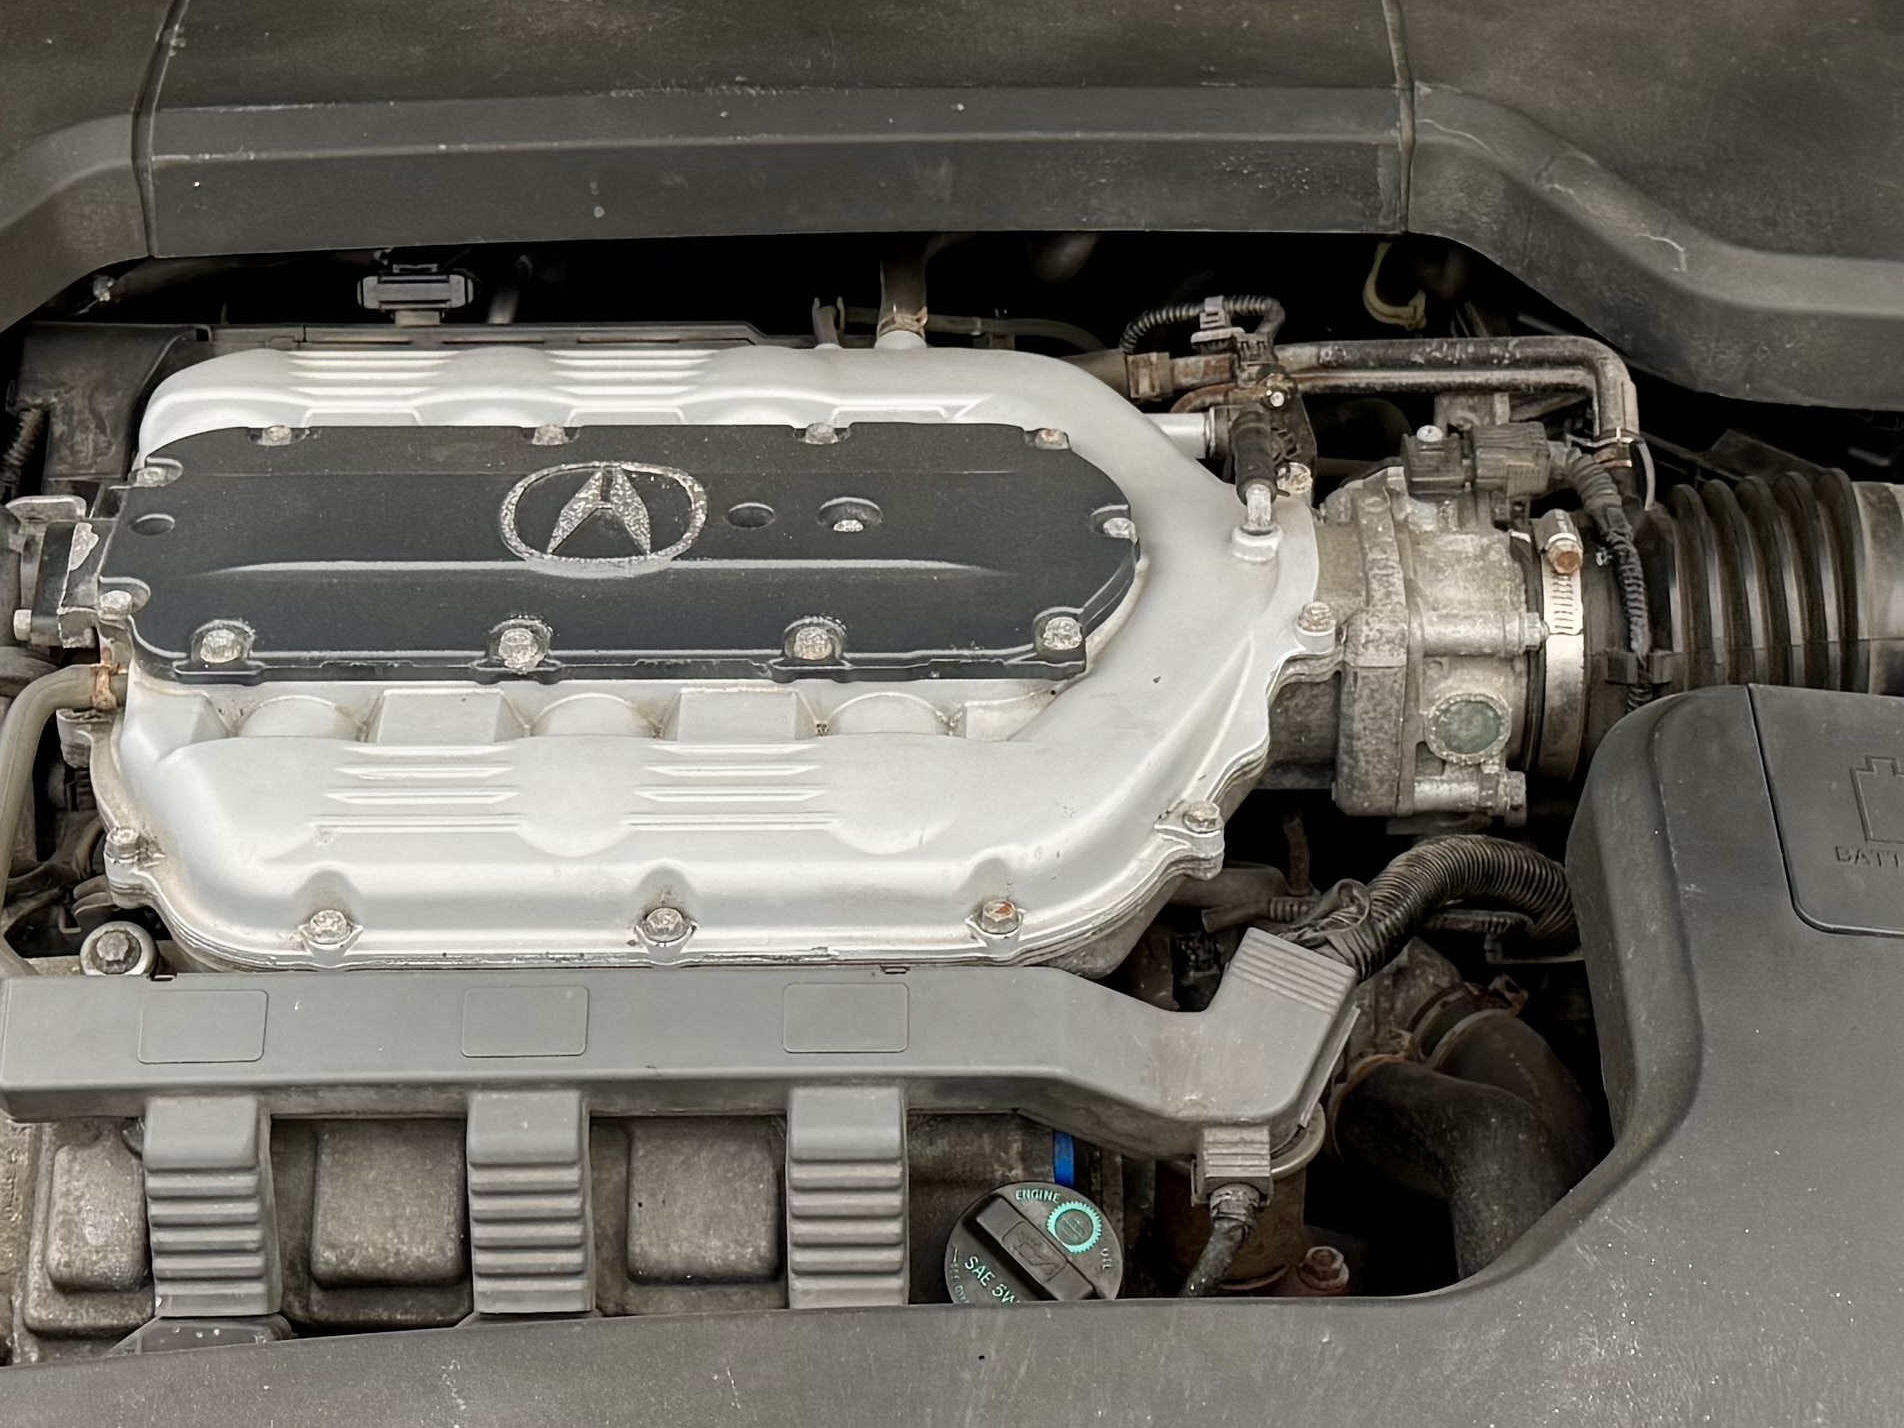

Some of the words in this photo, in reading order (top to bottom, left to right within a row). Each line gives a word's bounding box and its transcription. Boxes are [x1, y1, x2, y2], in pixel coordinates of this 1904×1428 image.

[1015, 1188, 1061, 1203] ENGINE
[1099, 1247, 1113, 1270] OIL
[965, 1256, 996, 1287] SAE
